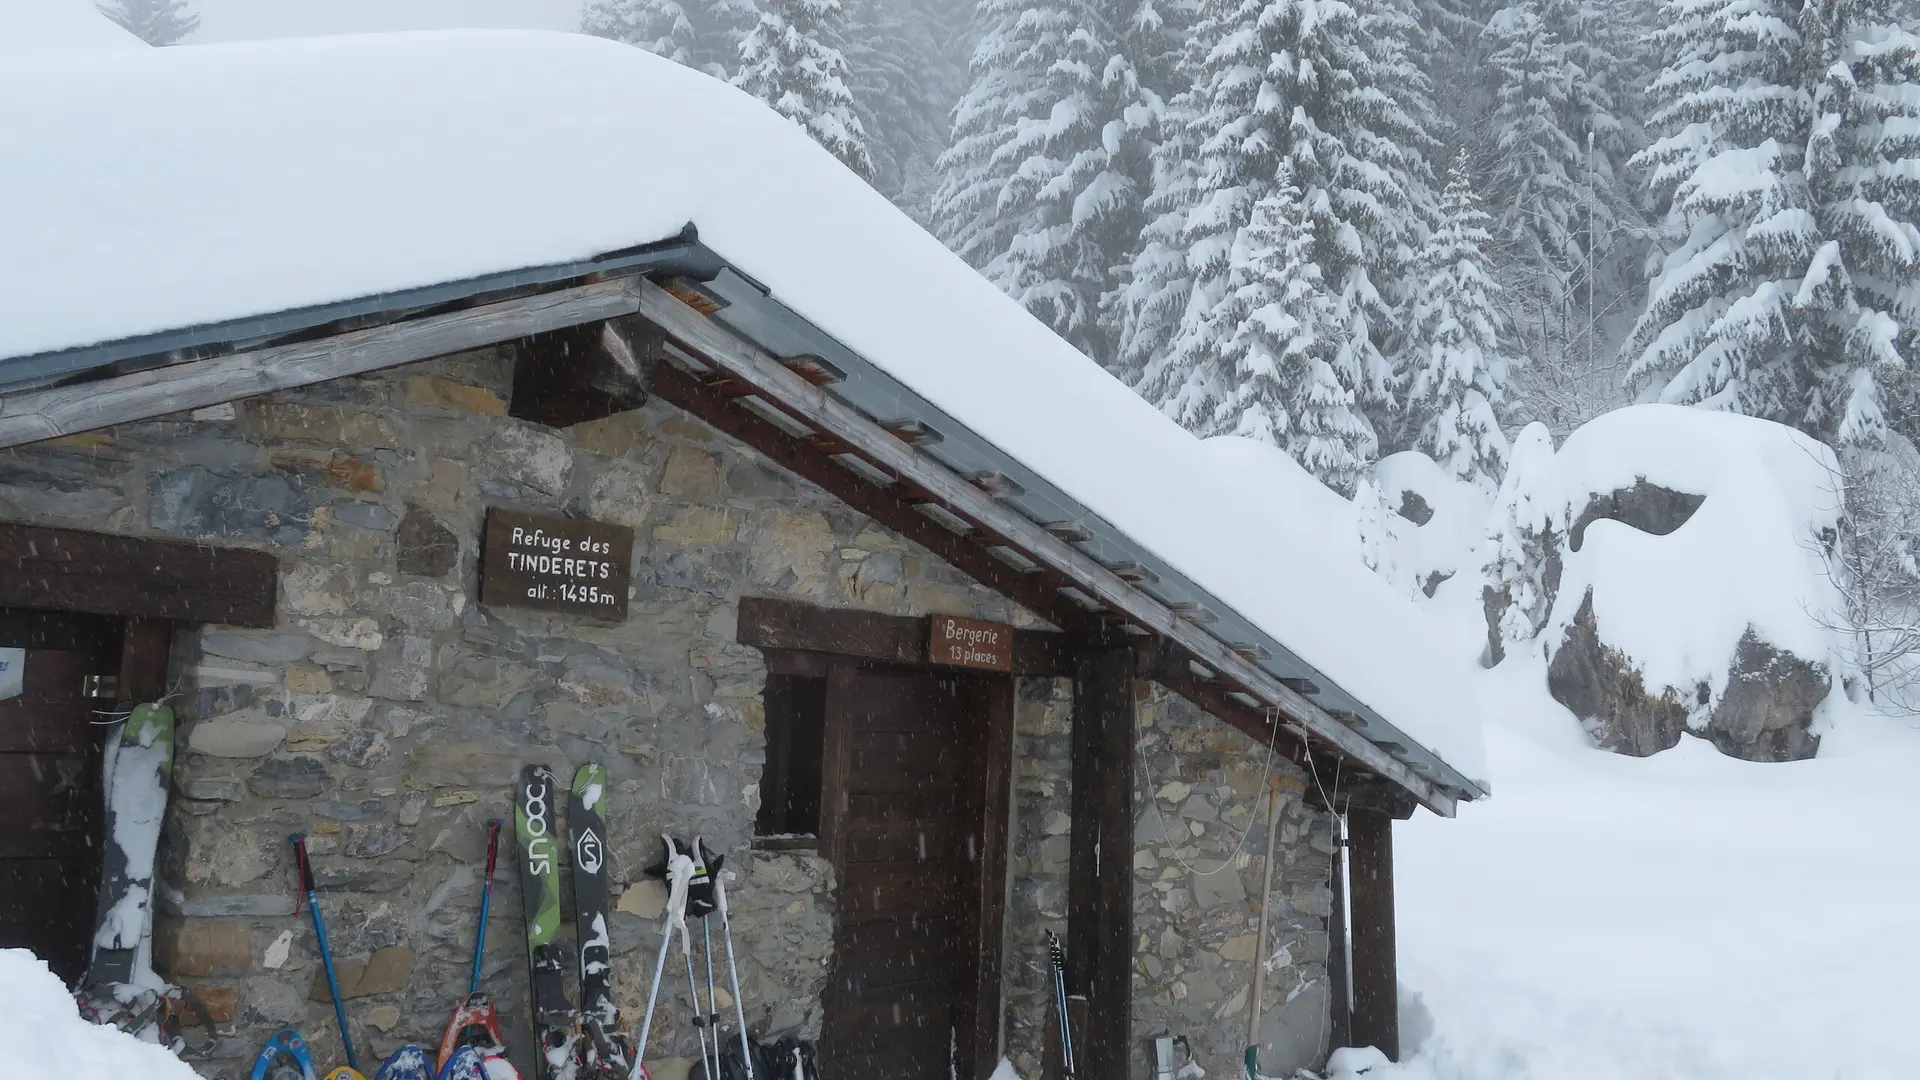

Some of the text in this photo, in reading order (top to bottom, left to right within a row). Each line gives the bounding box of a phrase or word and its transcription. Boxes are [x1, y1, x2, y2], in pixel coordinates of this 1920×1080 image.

[512, 527, 610, 554] Refuge des
[508, 552, 610, 579] TINDERETS
[560, 583, 615, 605] 1495m
[945, 619, 998, 646] Bergerie
[949, 645, 997, 666] 13 places
